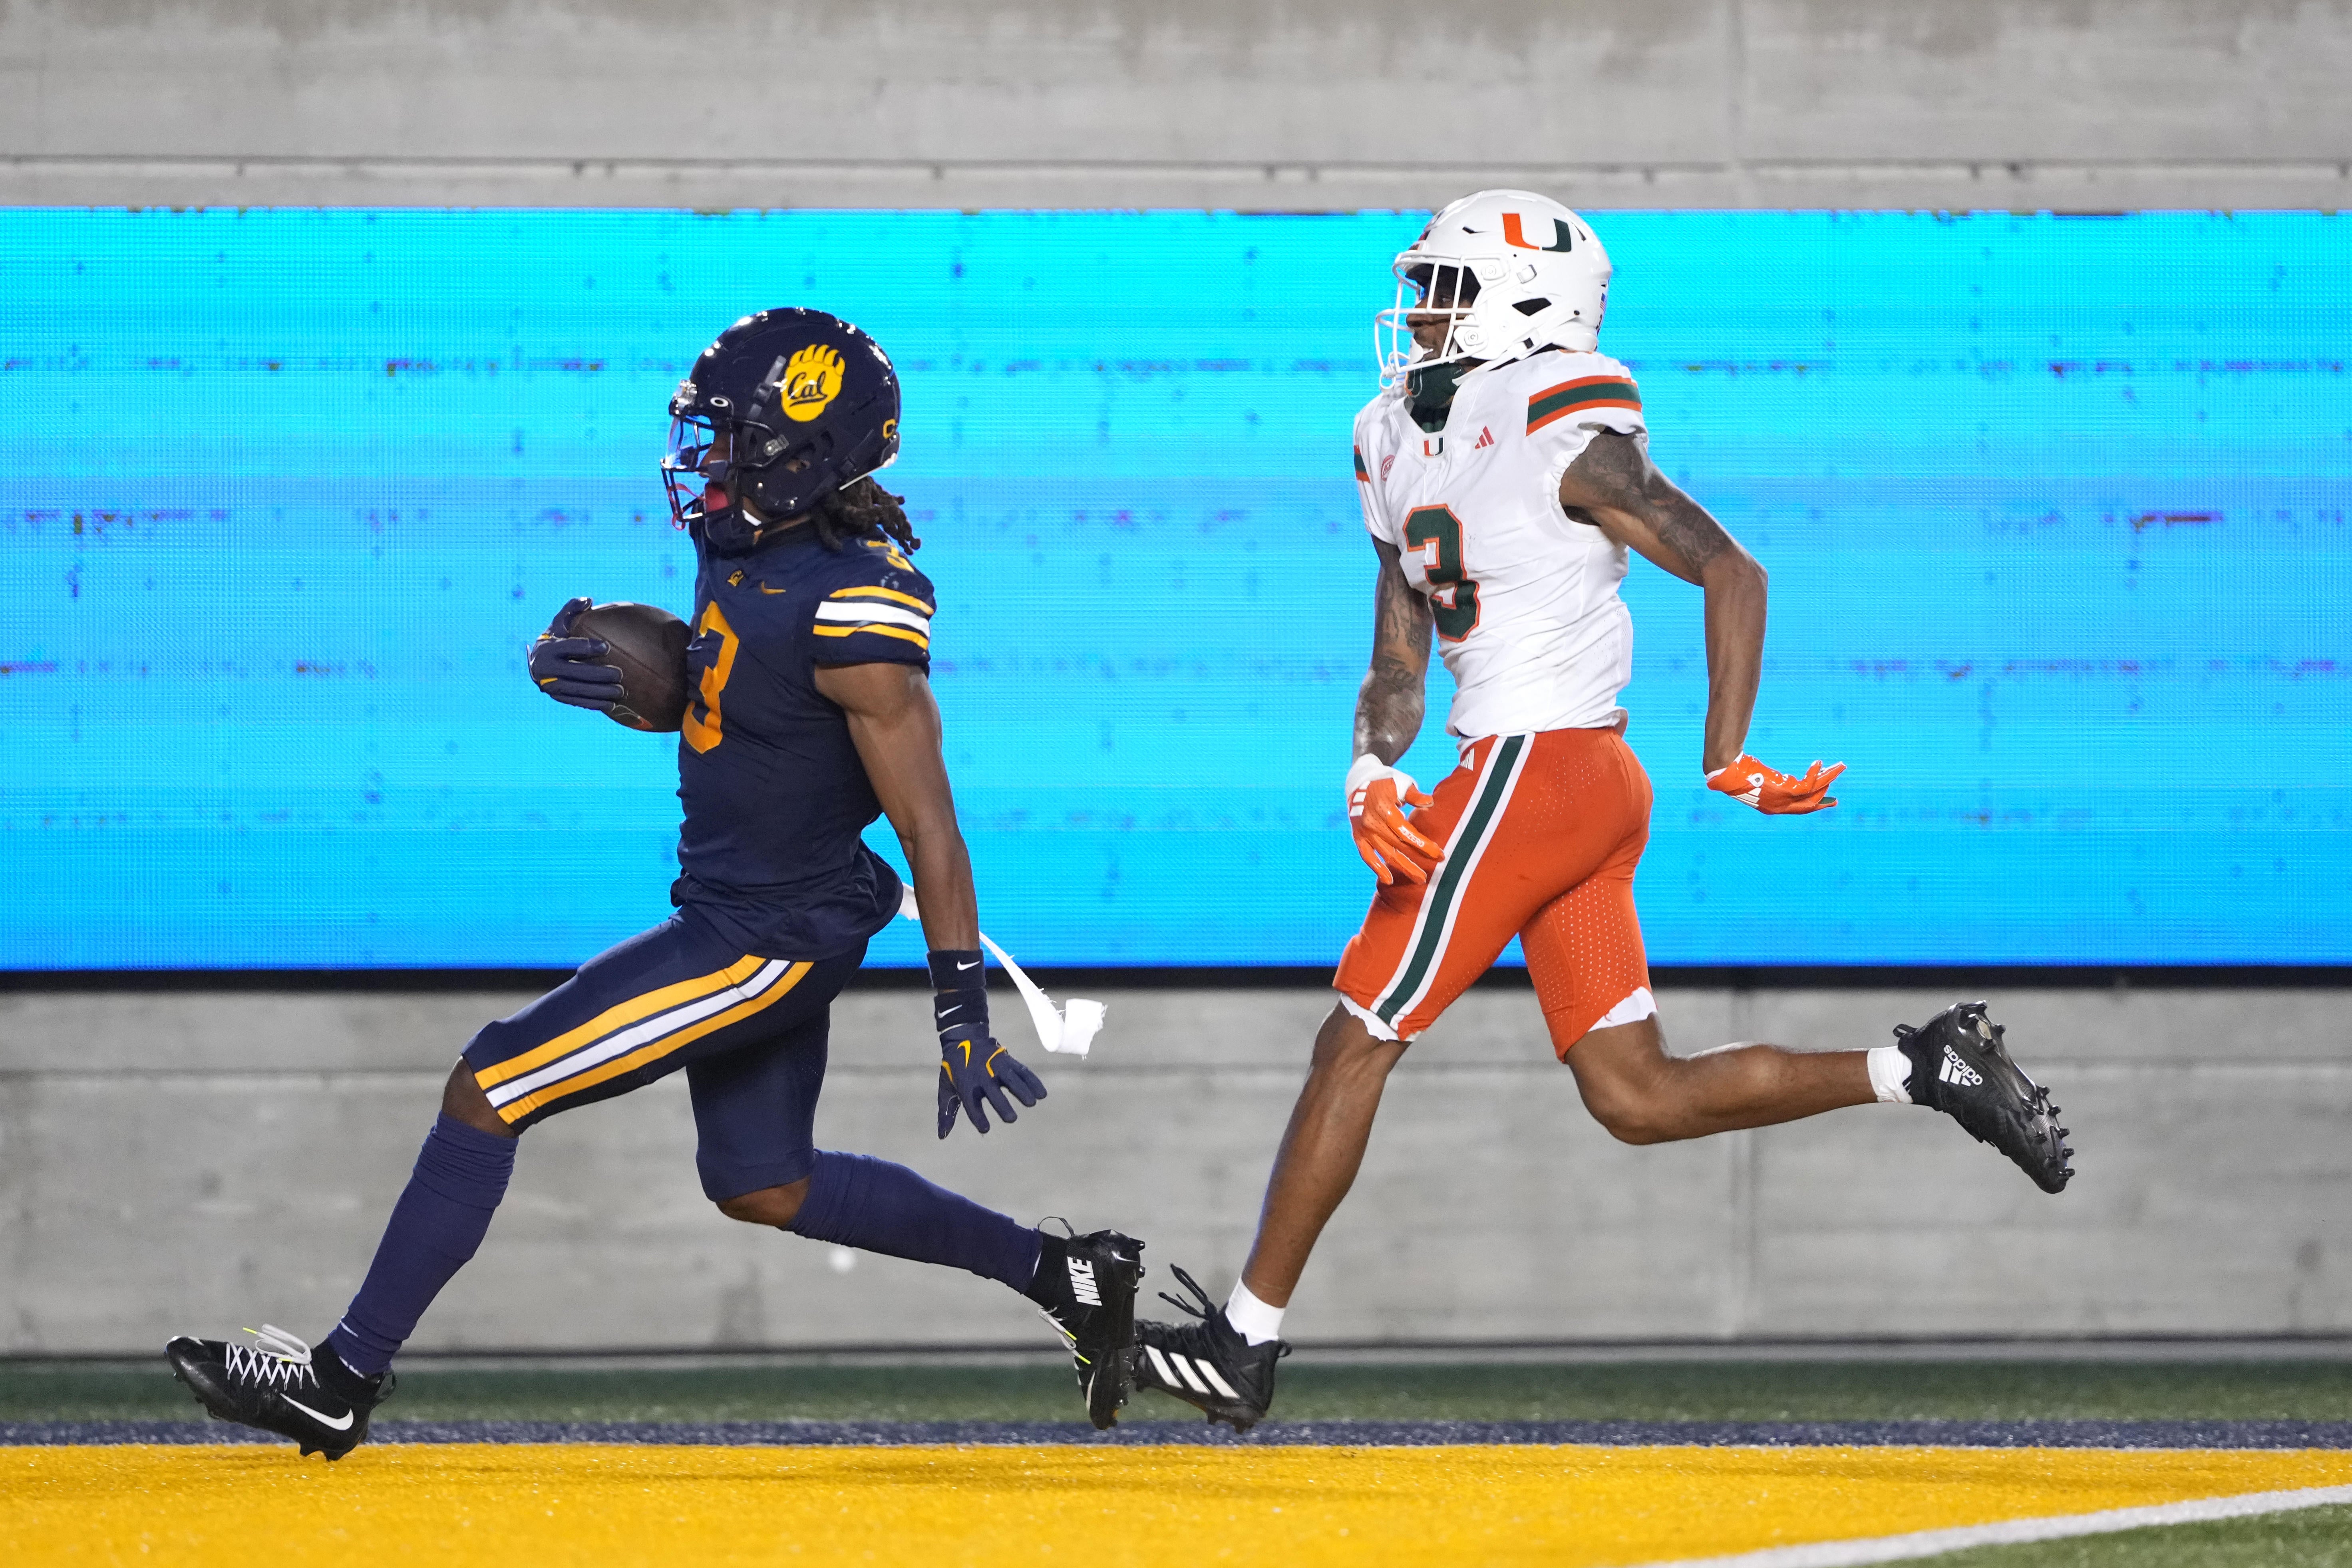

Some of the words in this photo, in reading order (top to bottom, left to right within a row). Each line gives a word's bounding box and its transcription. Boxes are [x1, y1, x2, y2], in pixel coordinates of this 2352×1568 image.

[1502, 213, 1572, 252] U
[788, 371, 828, 407] Cal
[1424, 438, 1443, 456] U
[1403, 503, 1481, 643] 3
[1944, 1045, 1983, 1085] adidas
[1067, 1256, 1102, 1306] NIKE
